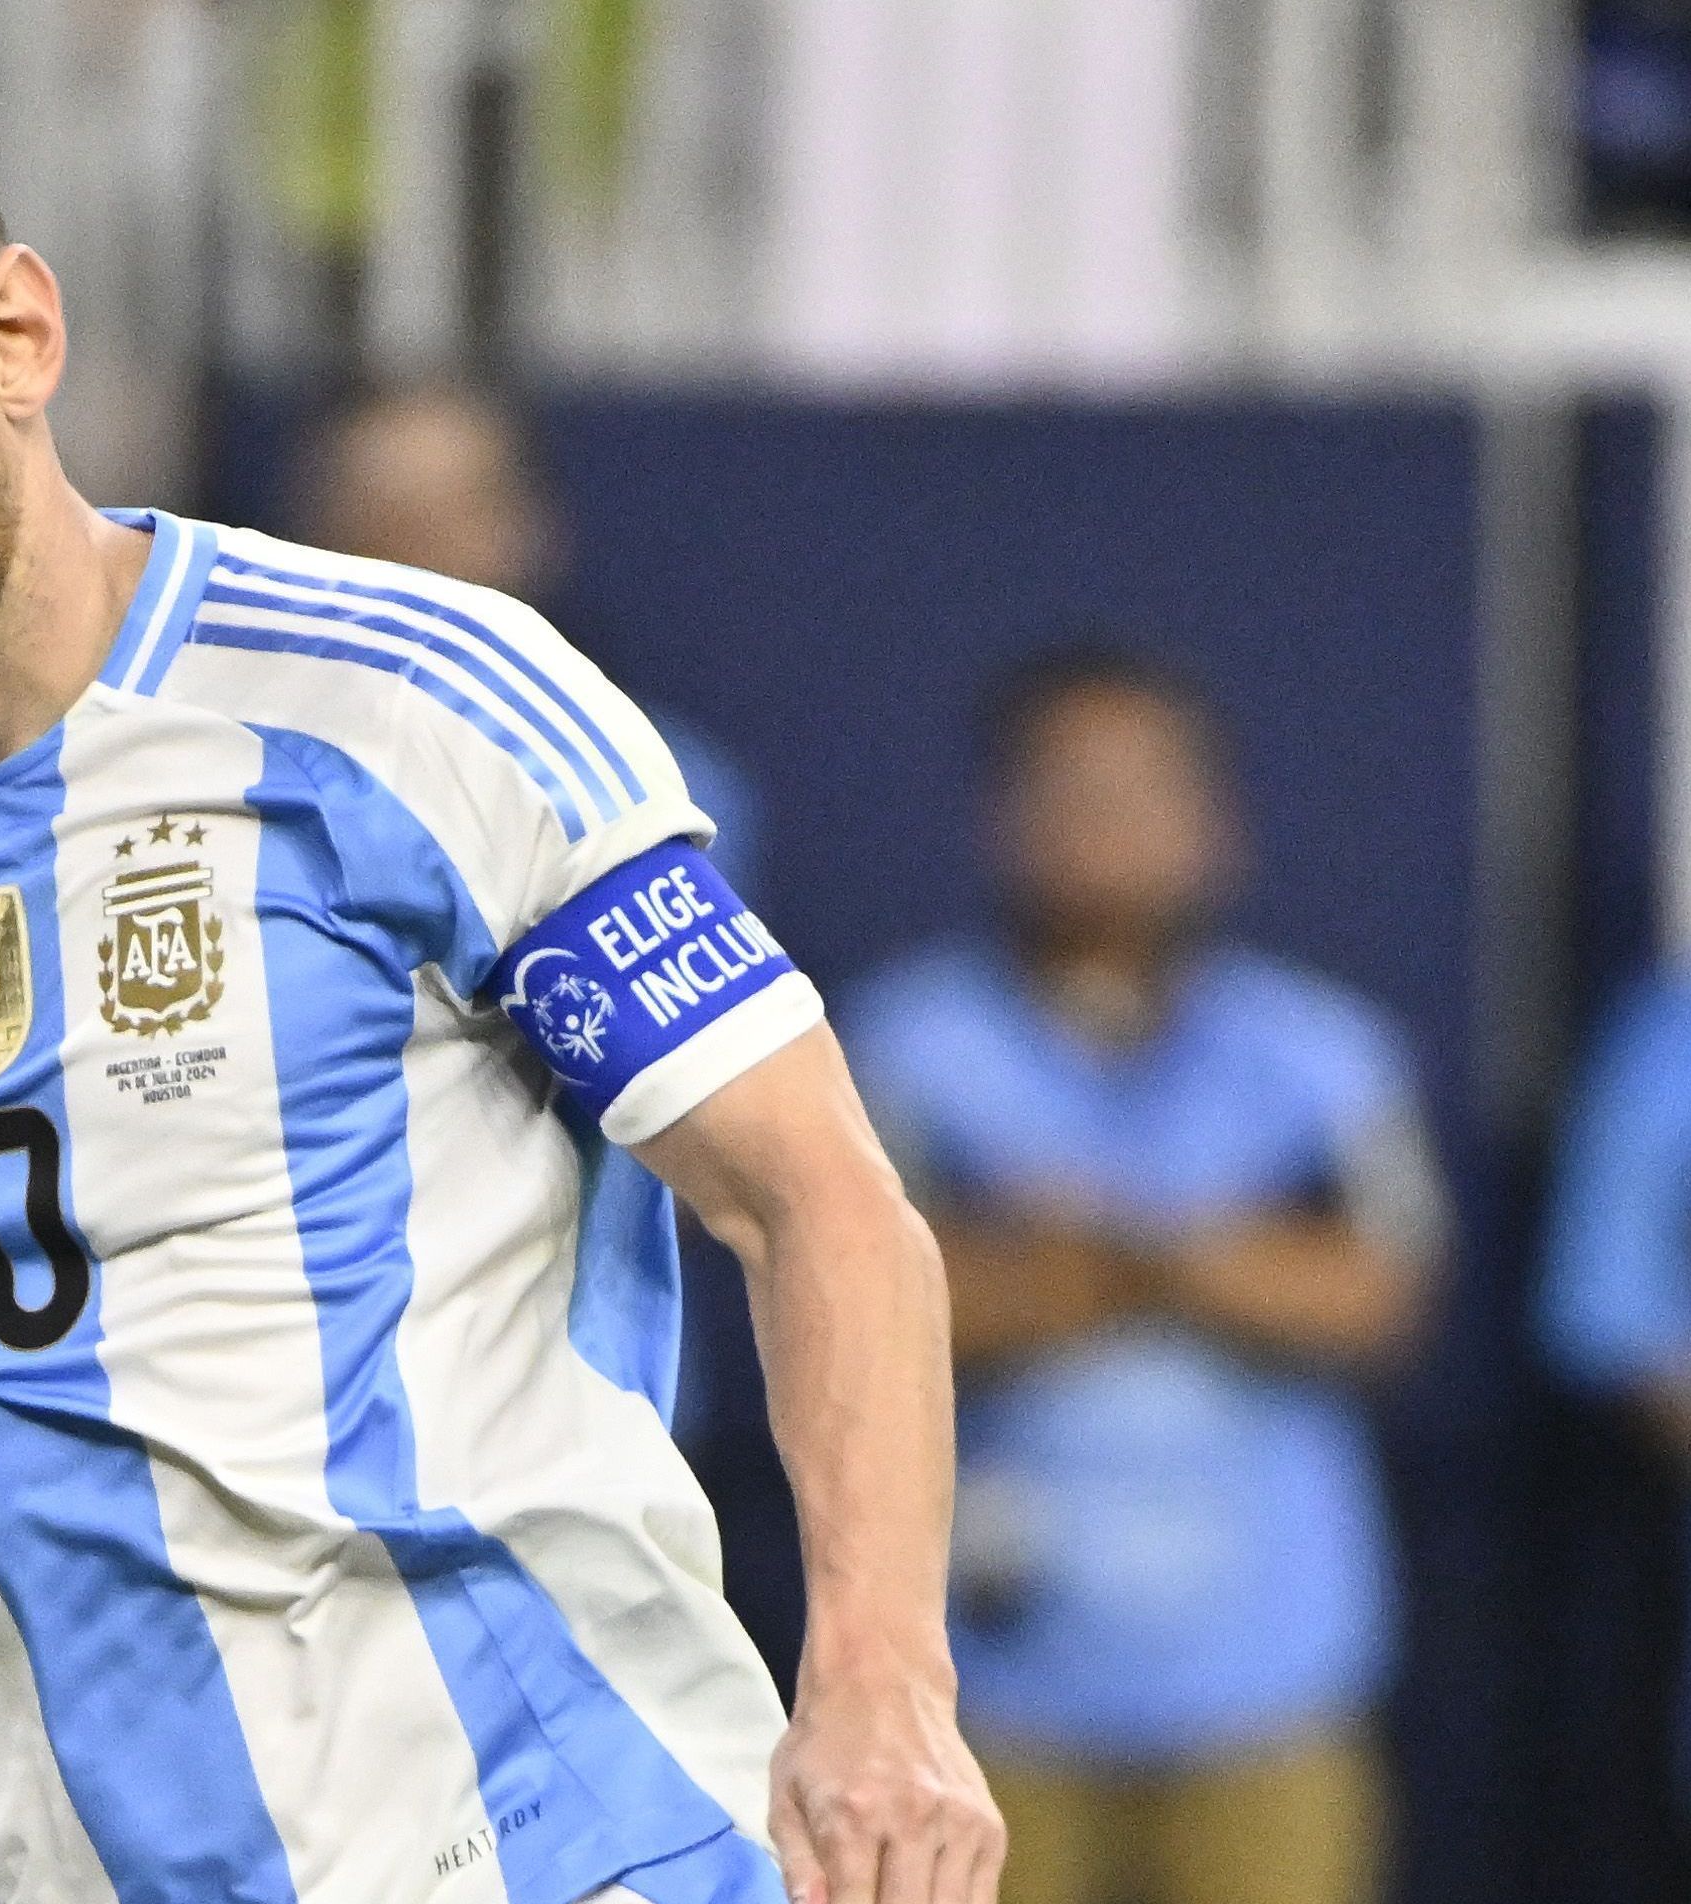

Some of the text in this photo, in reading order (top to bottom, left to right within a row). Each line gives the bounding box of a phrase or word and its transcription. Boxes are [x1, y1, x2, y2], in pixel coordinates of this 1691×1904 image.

[587, 865, 715, 972] ELIGE
[122, 905, 198, 989] AFA
[174, 1046, 227, 1066] ECUADOR
[186, 1065, 216, 1081] 2024
